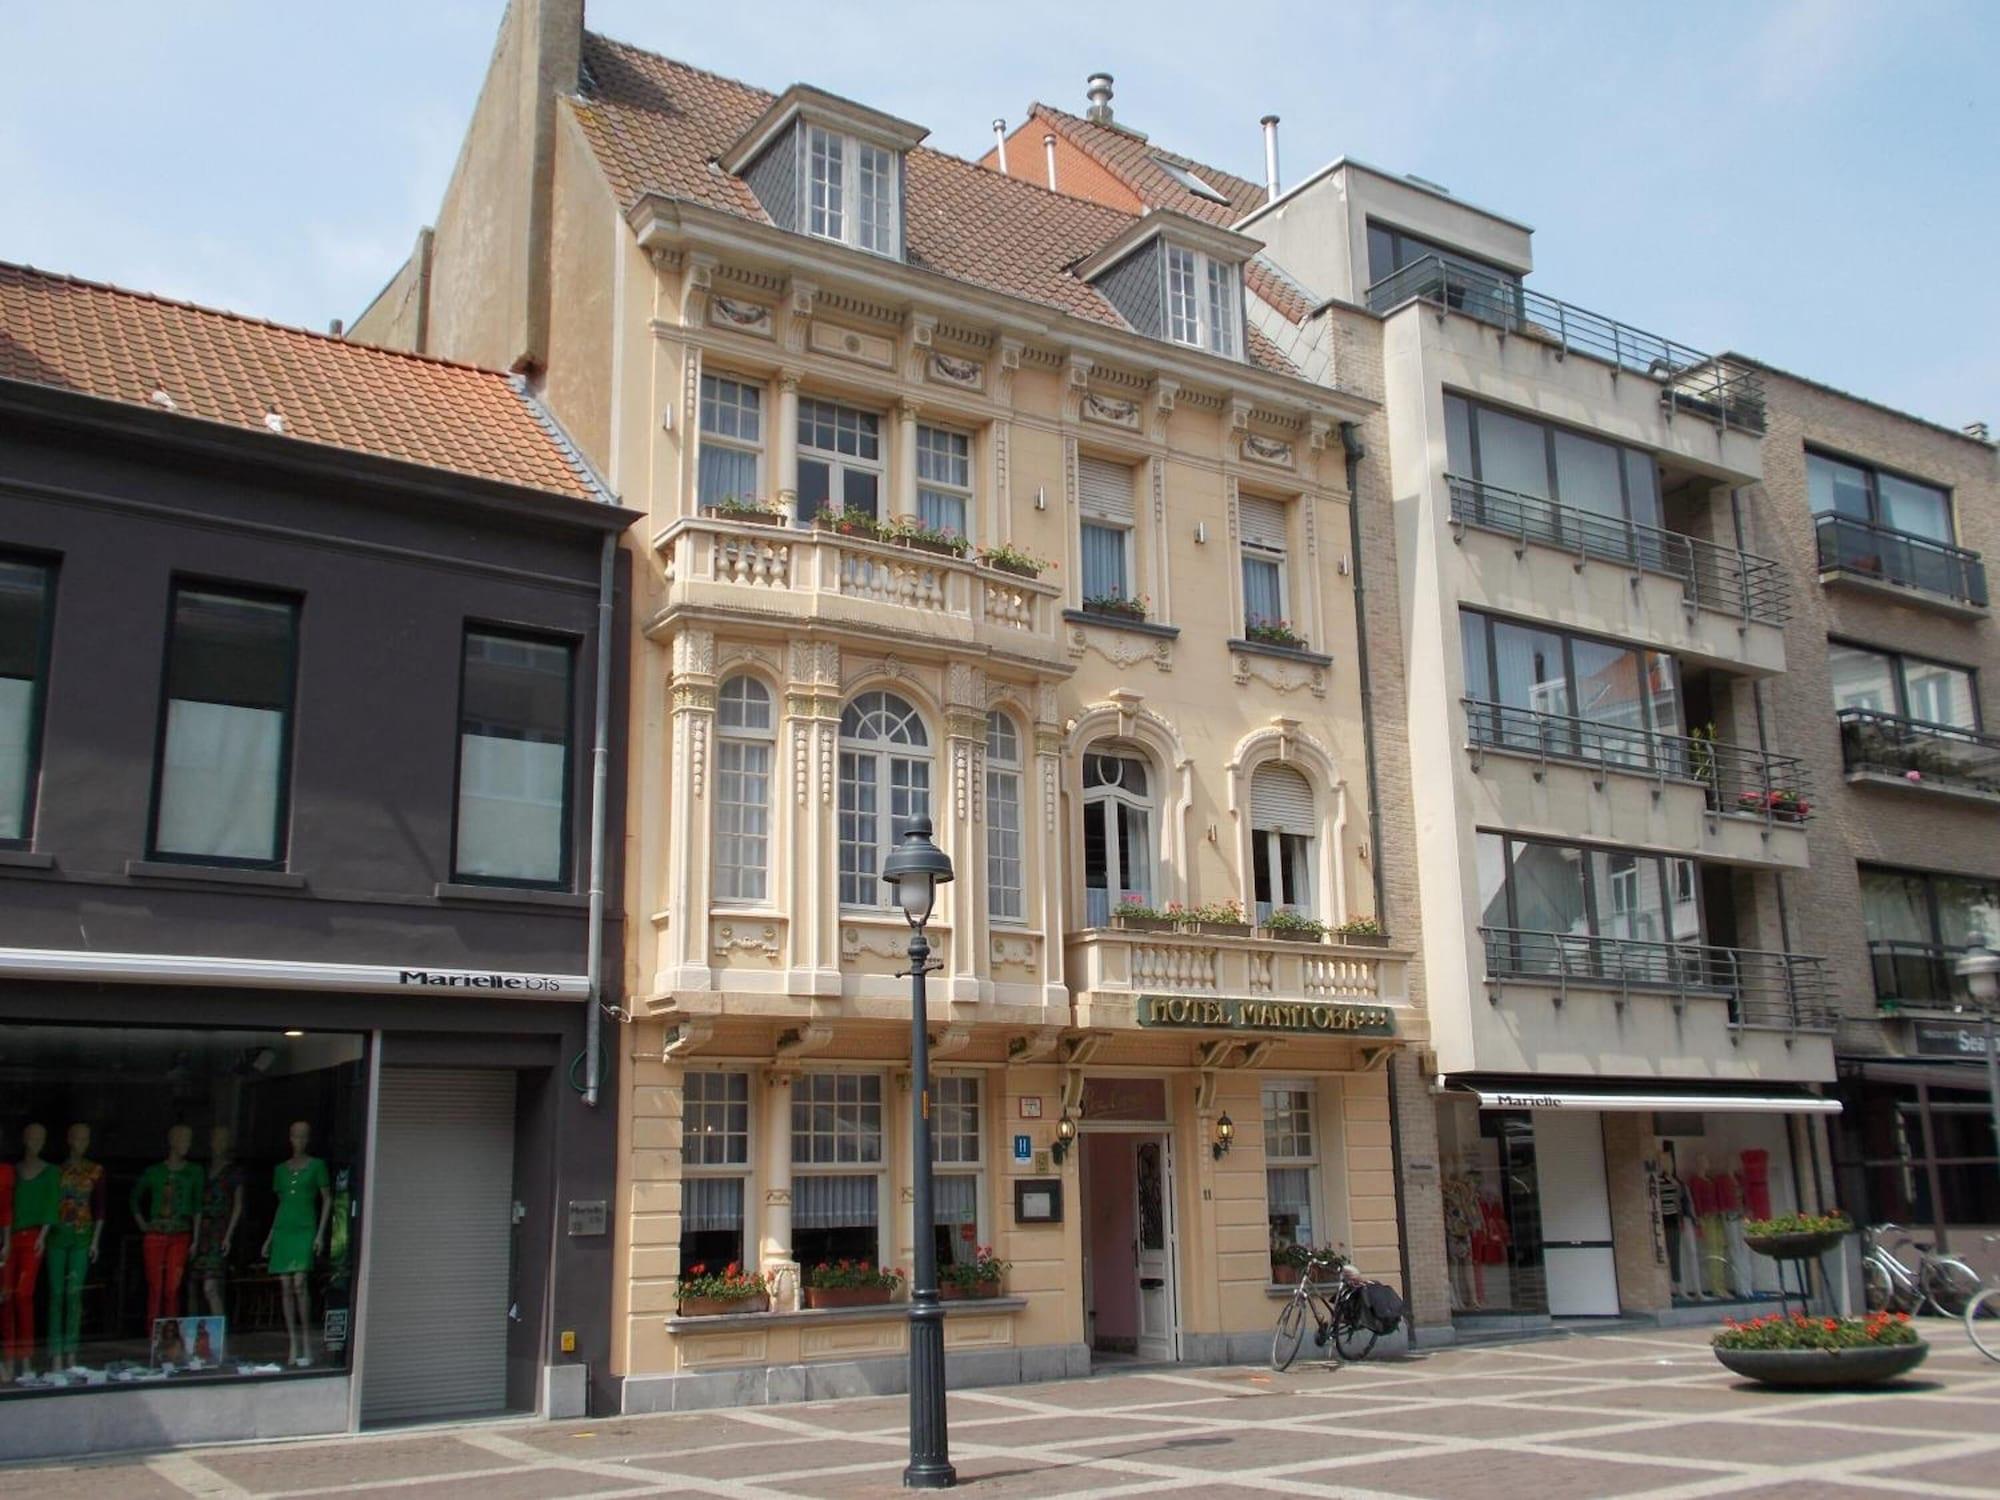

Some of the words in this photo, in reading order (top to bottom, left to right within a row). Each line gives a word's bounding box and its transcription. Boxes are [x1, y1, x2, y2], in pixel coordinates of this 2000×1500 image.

[399, 971, 521, 989] Marielle
[525, 976, 560, 991] bis
[1150, 997, 1233, 1025] HOTEL
[1497, 1095, 1562, 1107] Marielle
